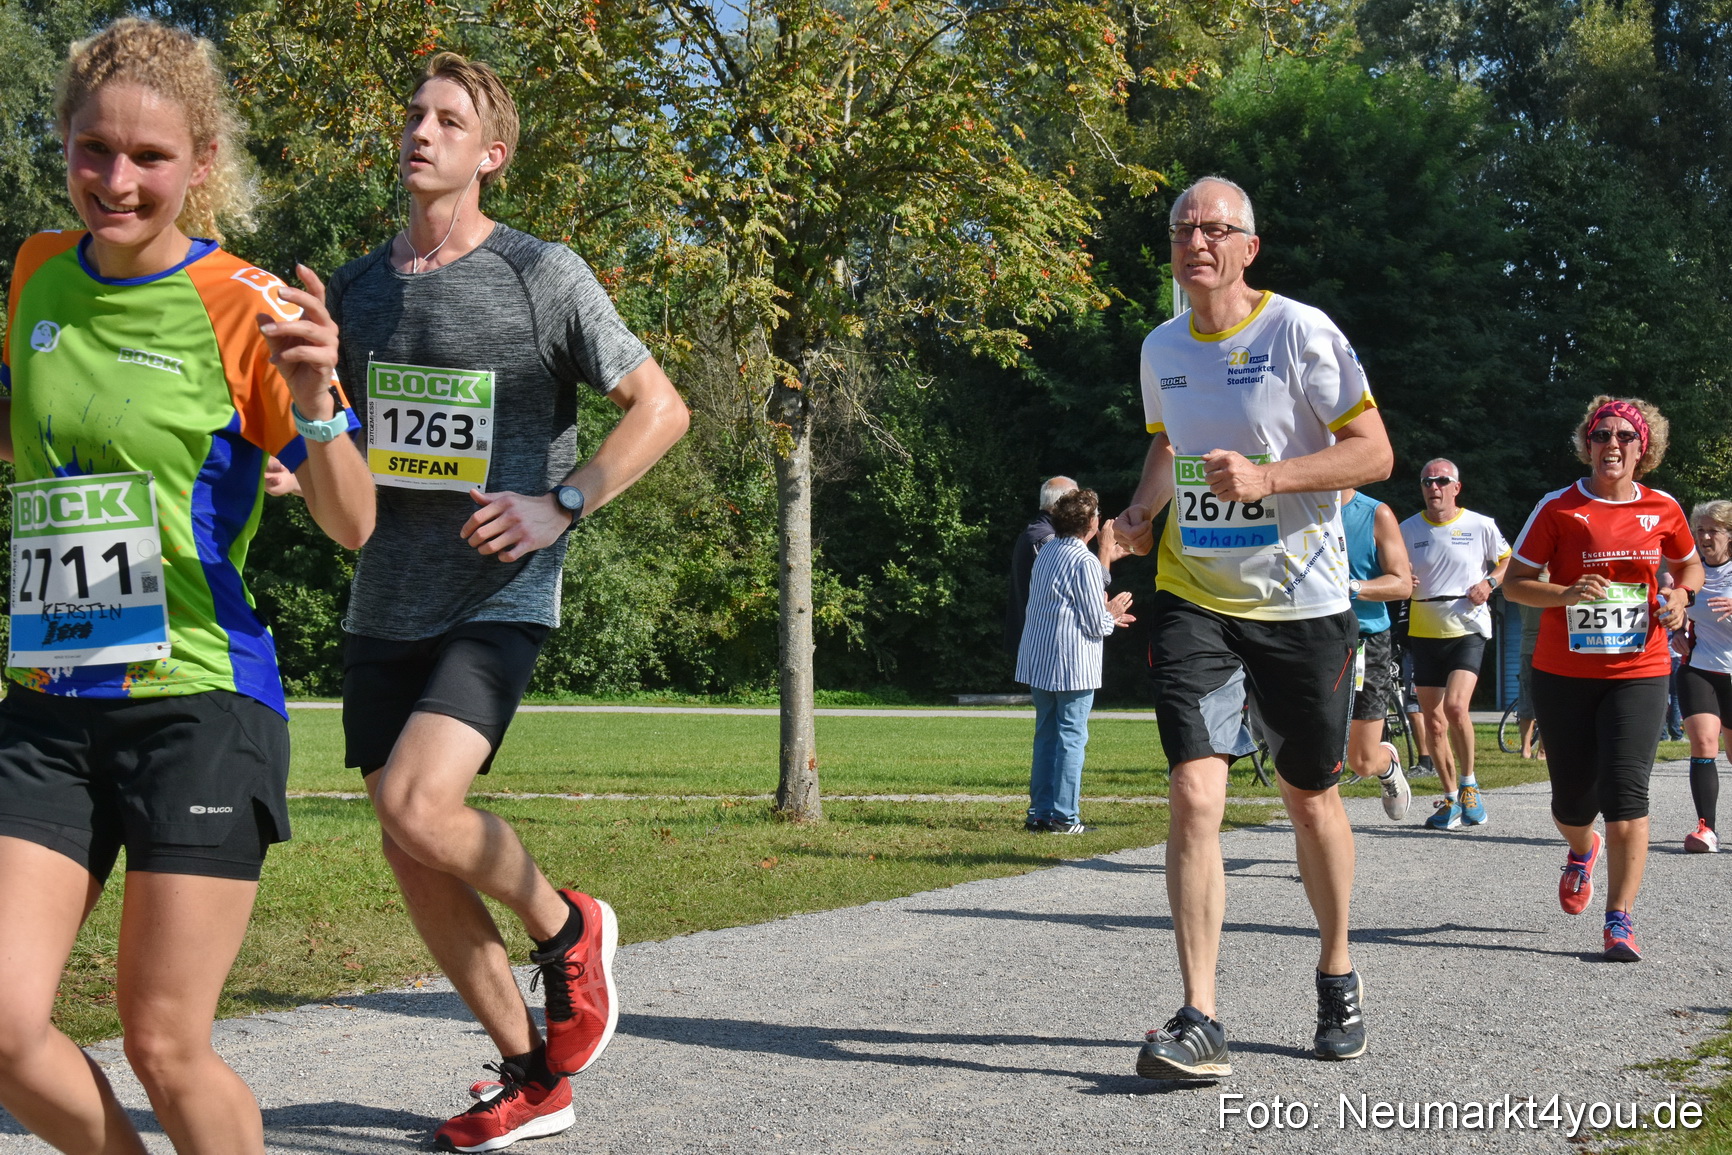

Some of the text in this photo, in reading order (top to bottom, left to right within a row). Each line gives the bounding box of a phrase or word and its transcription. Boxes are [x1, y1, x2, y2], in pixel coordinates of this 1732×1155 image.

[118, 347, 184, 375] BOCK
[1229, 351, 1250, 365] 20
[1227, 365, 1276, 375] Neumarkter
[1227, 375, 1265, 385] Stadtlauf
[376, 368, 481, 403] BOCK
[1161, 376, 1187, 387] BOCK
[383, 408, 474, 450] 1263
[388, 456, 458, 476] STEFAN
[17, 481, 139, 531] BOCK
[1190, 529, 1265, 547] Johann
[1582, 550, 1630, 559] ENGELHARDT
[20, 542, 132, 602] 2711
[41, 602, 122, 624] KERSTIN
[1577, 608, 1638, 629] 2517
[1586, 636, 1633, 645] MARION
